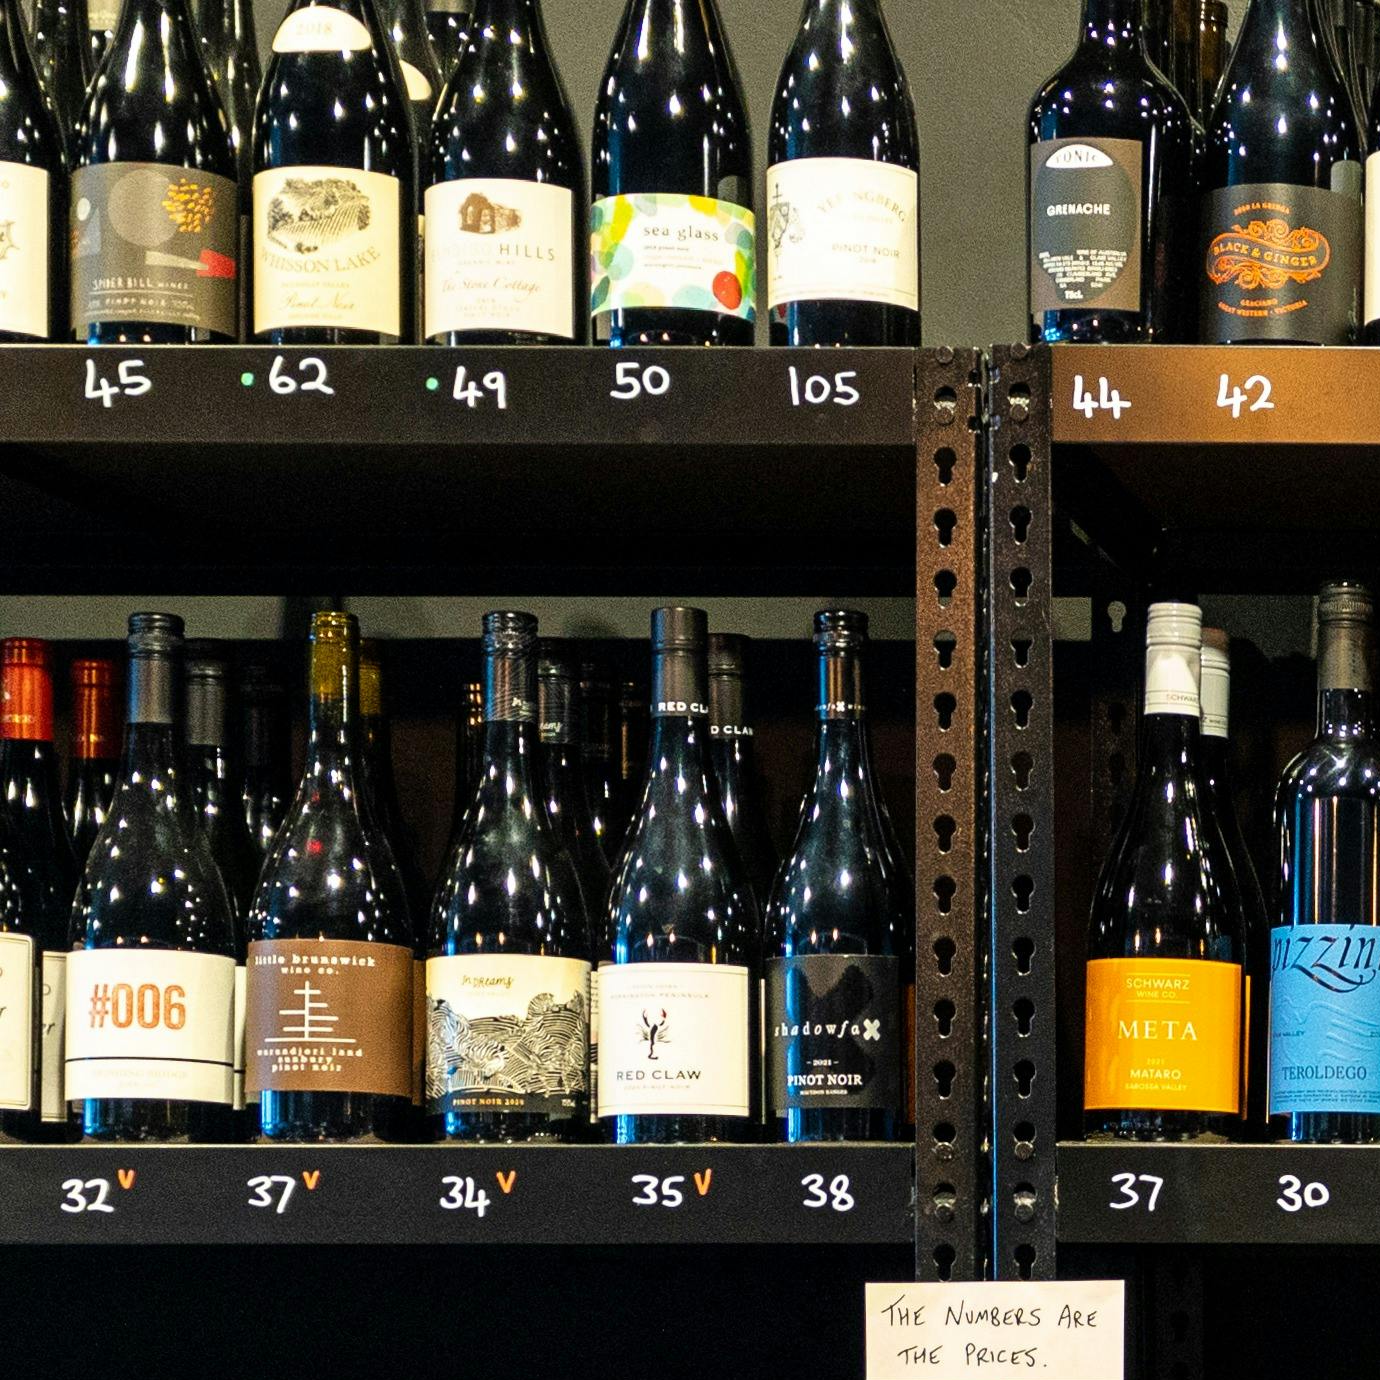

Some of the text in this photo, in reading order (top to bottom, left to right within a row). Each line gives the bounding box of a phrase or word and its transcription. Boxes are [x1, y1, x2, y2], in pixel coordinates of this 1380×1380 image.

[1047, 203, 1110, 217] GRENACHE
[643, 222, 719, 243] sea glass
[1213, 239, 1248, 256] BLACK
[1263, 250, 1317, 268] GINGER
[84, 358, 152, 408] 45
[268, 354, 335, 395] 62
[452, 365, 507, 410] 49
[609, 361, 671, 400] 50
[788, 365, 860, 406] 105
[1071, 375, 1132, 420] 44
[1216, 373, 1275, 419] 42
[1126, 977, 1189, 990] SCHWARZ
[90, 983, 186, 1029] #006
[1118, 1020, 1198, 1041] META
[616, 1070, 701, 1081] RED CLAW
[788, 1074, 862, 1087] PINOT NOIR
[1130, 1069, 1181, 1080] MATARO
[1282, 1066, 1367, 1081] TEROLDEGO
[60, 1177, 115, 1214] 32
[246, 1174, 297, 1215] 37
[439, 1175, 491, 1218] 34
[631, 1173, 685, 1208] 35
[800, 1173, 855, 1212] 38
[1109, 1172, 1164, 1212] 37
[1276, 1174, 1330, 1212] 30
[882, 1294, 1097, 1328] THE NUMBERS ARE
[898, 1346, 942, 1364] THE
